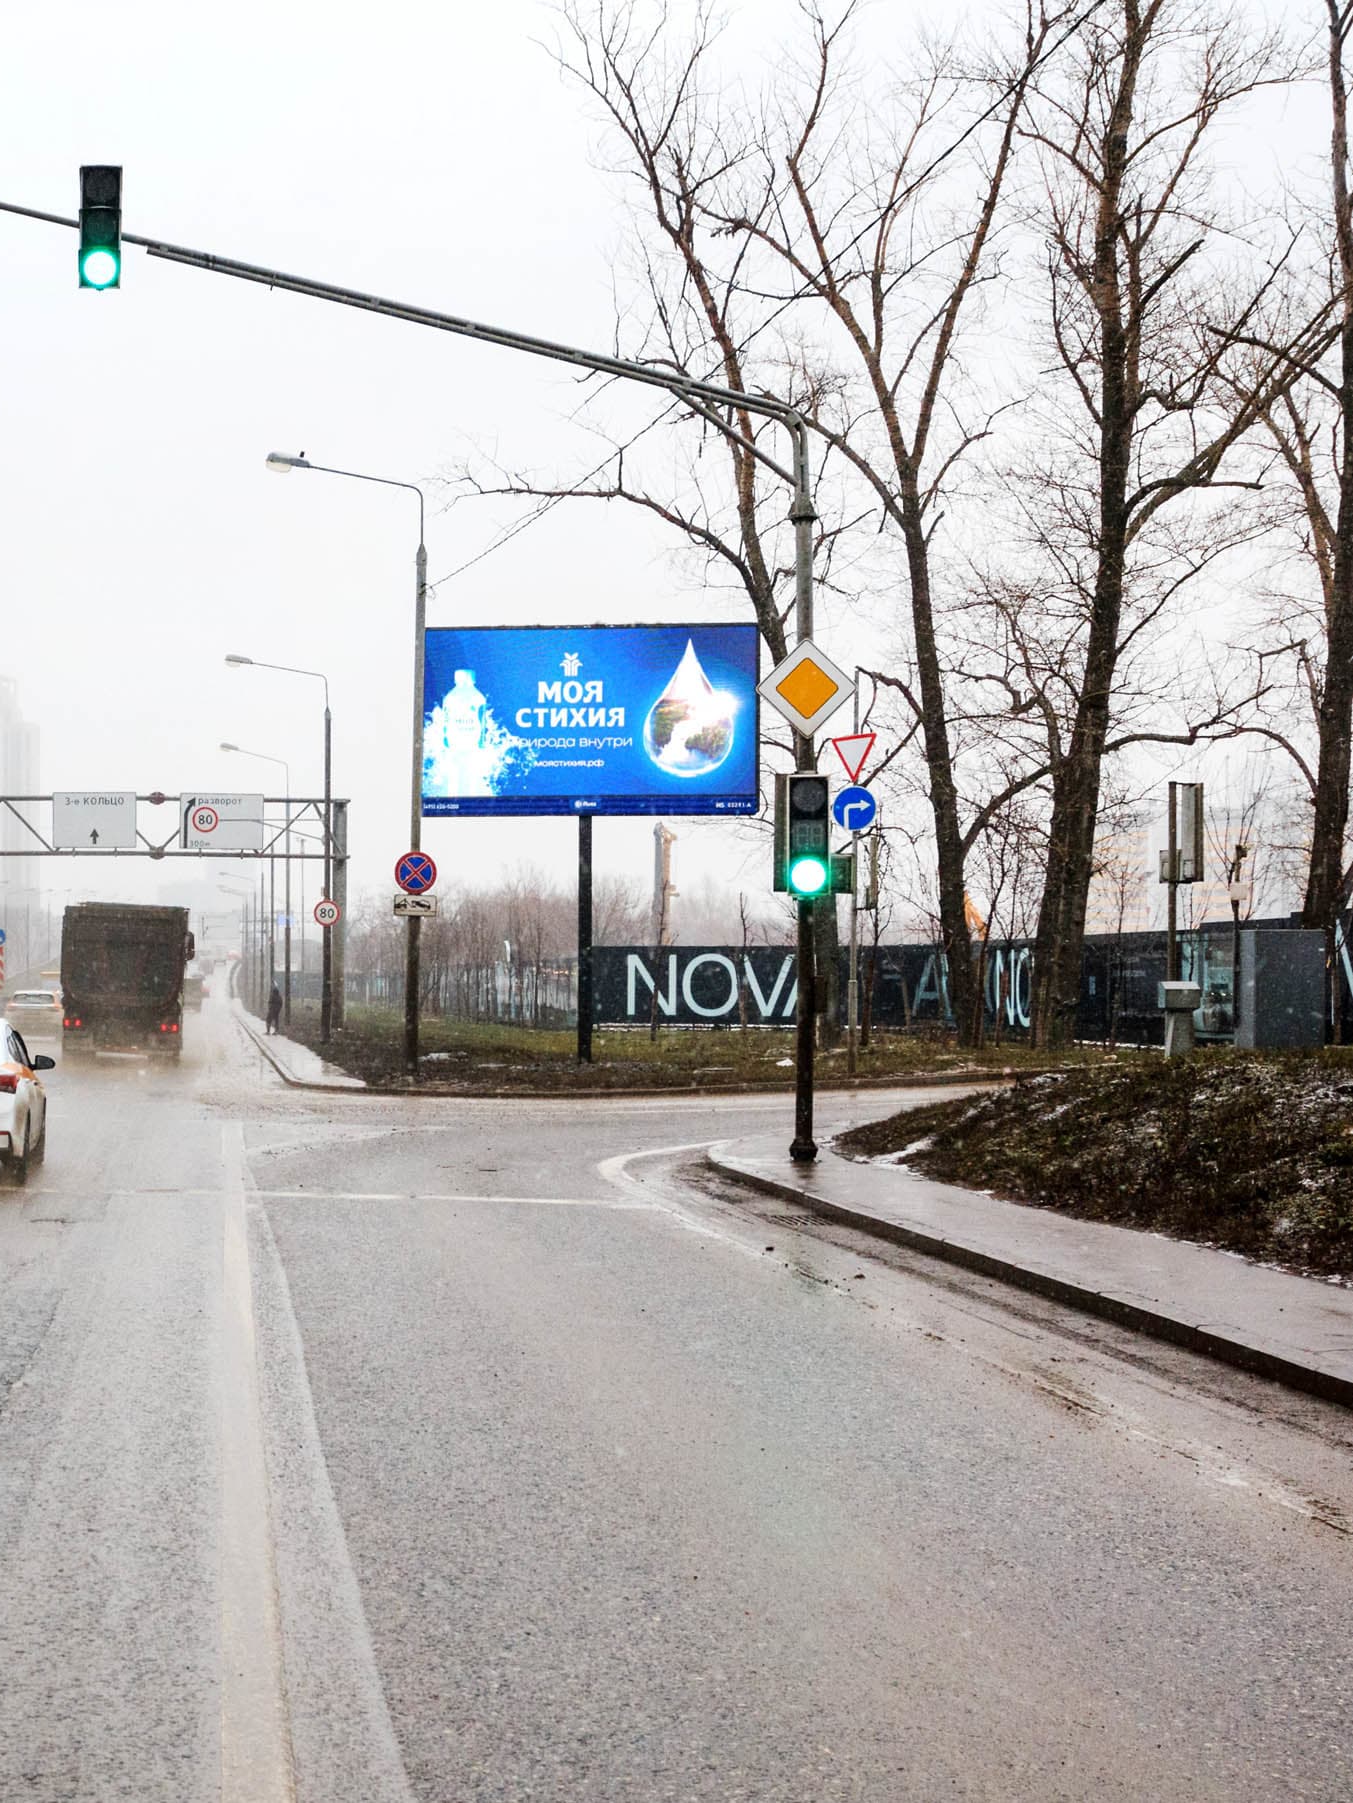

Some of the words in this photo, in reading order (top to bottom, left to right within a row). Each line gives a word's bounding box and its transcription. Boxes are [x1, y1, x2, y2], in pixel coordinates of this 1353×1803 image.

[537, 681, 603, 704] МОЯ
[515, 707, 625, 728] СТИХИЯ
[510, 736, 576, 749] рирода
[579, 737, 633, 749] внутри
[83, 796, 125, 807] КОЛЬЦО
[198, 798, 242, 806] разворот
[198, 814, 213, 825] 80
[319, 908, 335, 919] 80
[626, 952, 799, 1017] NOV
